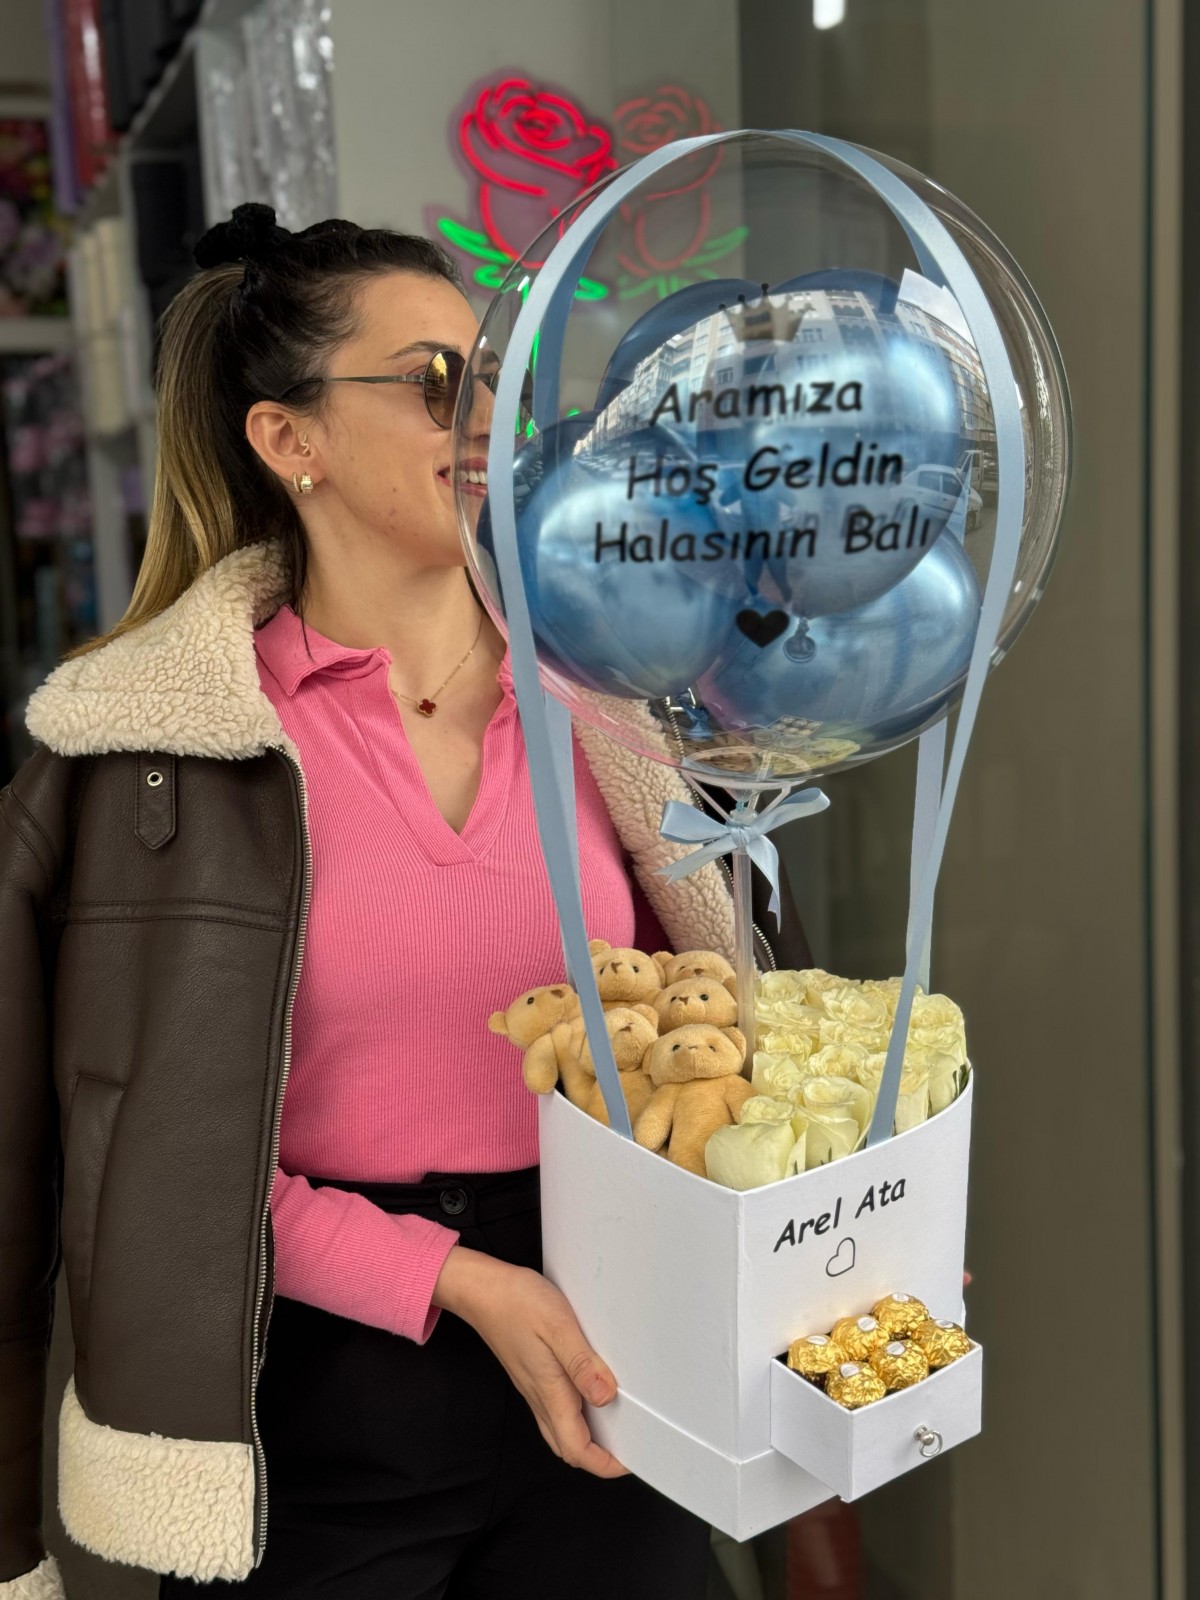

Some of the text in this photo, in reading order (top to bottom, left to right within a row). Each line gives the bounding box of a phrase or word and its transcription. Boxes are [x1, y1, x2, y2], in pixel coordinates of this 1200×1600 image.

[649, 381, 864, 426] Aramıza
[627, 441, 903, 504] Hoş Geldin
[594, 505, 930, 563] Halasının Balı
[773, 1178, 906, 1253] Arel Ata
